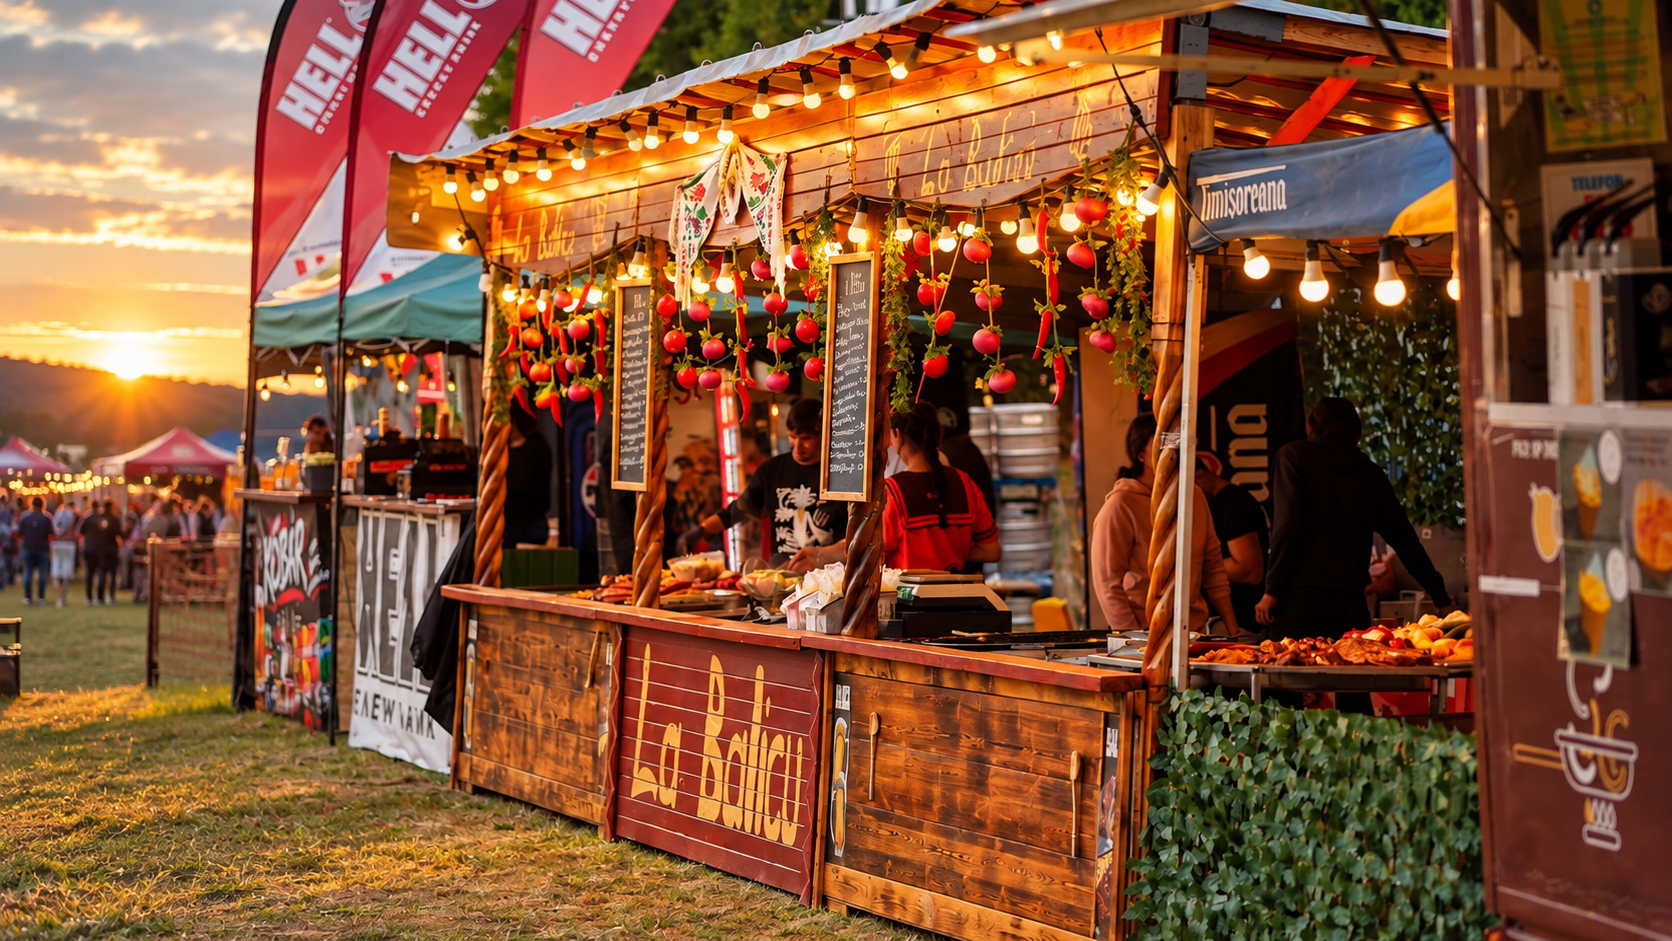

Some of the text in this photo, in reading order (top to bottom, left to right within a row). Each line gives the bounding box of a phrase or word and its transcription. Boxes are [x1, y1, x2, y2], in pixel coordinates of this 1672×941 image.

[275, 22, 364, 131] HELL
[372, 0, 473, 113] HELL
[631, 643, 682, 809] La
